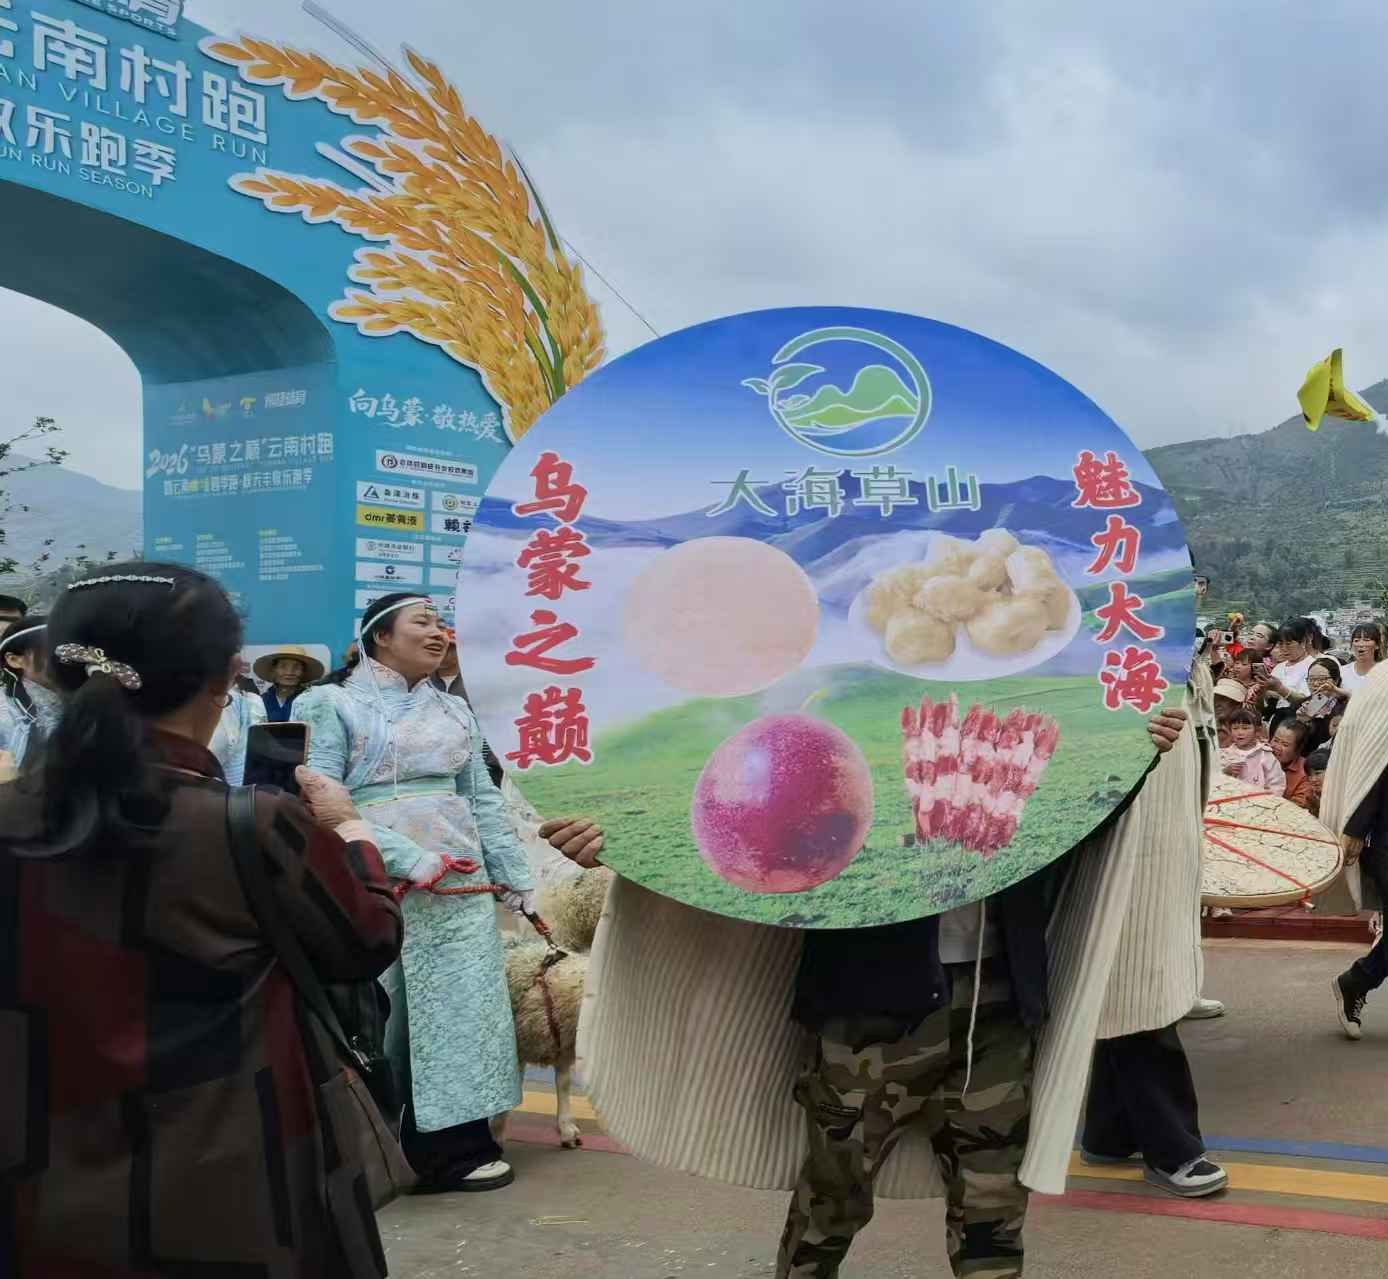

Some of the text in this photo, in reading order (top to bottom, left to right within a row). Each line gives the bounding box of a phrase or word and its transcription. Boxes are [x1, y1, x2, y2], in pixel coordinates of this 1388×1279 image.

[0, 0, 268, 145] 南村跑
[58, 82, 195, 142] VILLAGE
[212, 133, 266, 165] RUN
[31, 154, 71, 176] RUN
[79, 168, 152, 198] SEASON
[145, 443, 189, 478] 2026
[706, 465, 983, 518] 大海草山
[504, 449, 597, 769] 乌蒙之巅
[1071, 449, 1170, 714] 魅力大海
